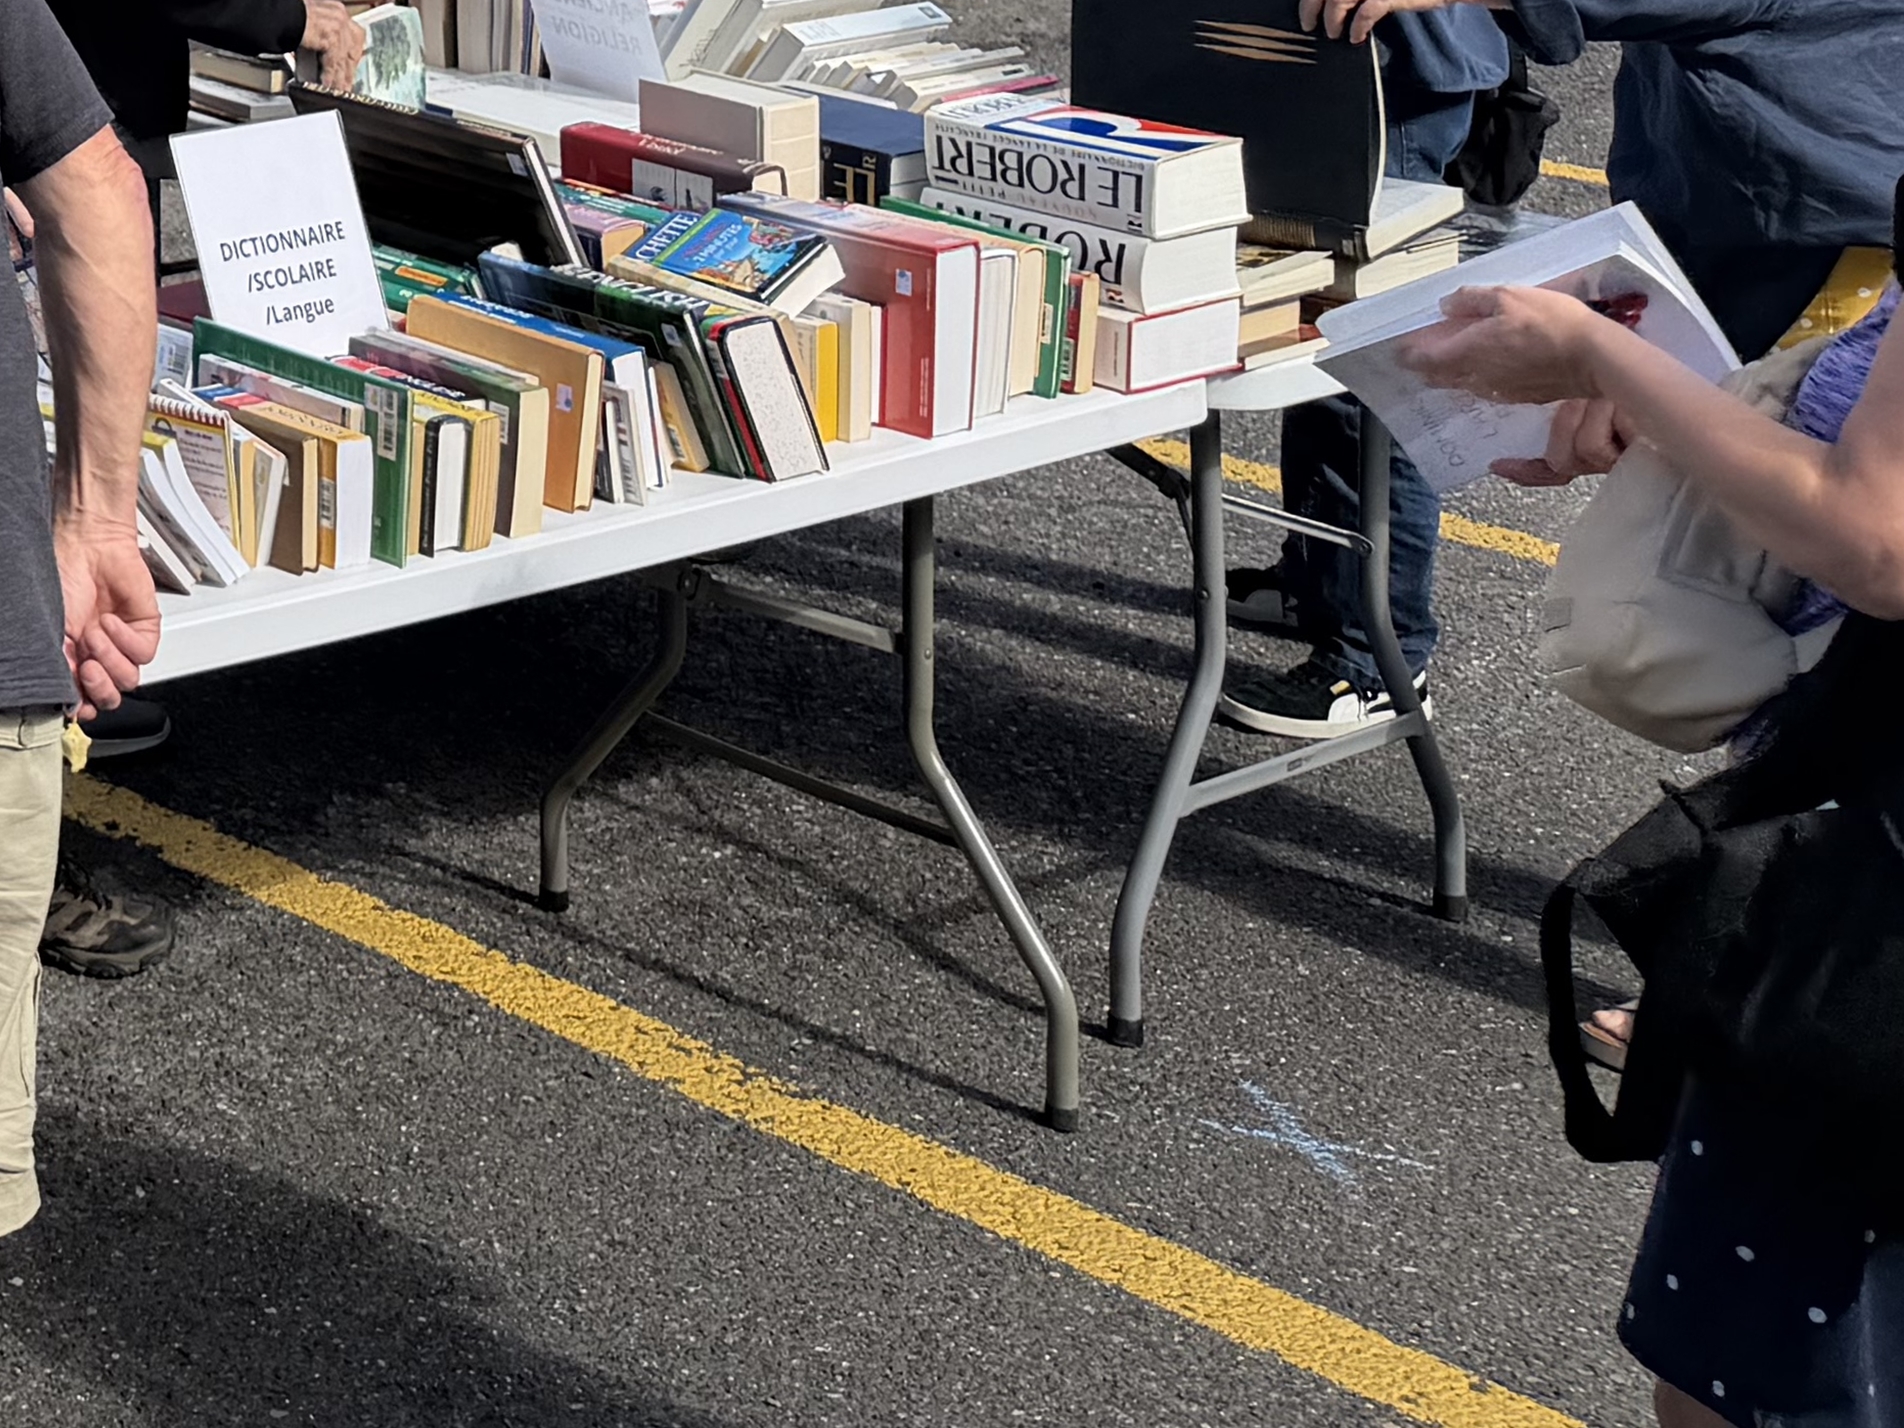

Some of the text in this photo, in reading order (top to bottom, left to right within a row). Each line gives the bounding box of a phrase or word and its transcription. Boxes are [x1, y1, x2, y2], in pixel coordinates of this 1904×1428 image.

[933, 134, 1144, 213] LE ROBERT
[218, 220, 347, 263] DICTIONNAIRE
[246, 257, 338, 295] /SCOLAIRE
[265, 294, 335, 329] /Langue
